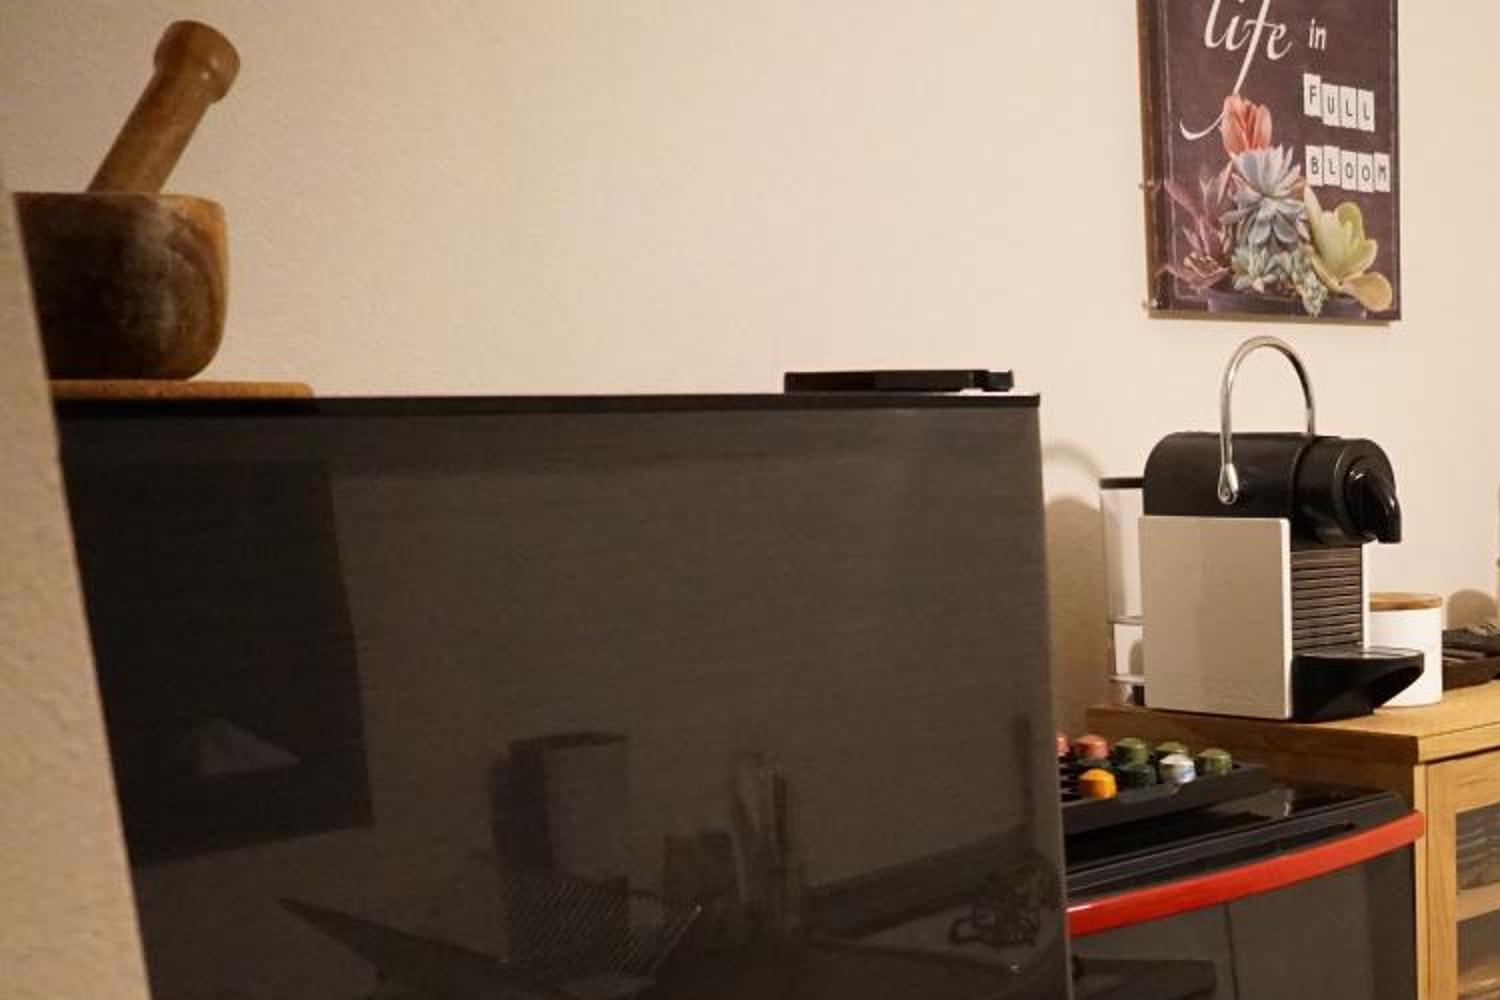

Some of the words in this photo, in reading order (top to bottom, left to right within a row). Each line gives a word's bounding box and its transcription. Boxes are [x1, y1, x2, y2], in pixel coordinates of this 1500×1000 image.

[1308, 18, 1327, 50] in
[1307, 83, 1372, 123] FULL
[1308, 154, 1388, 183] BLOOM
